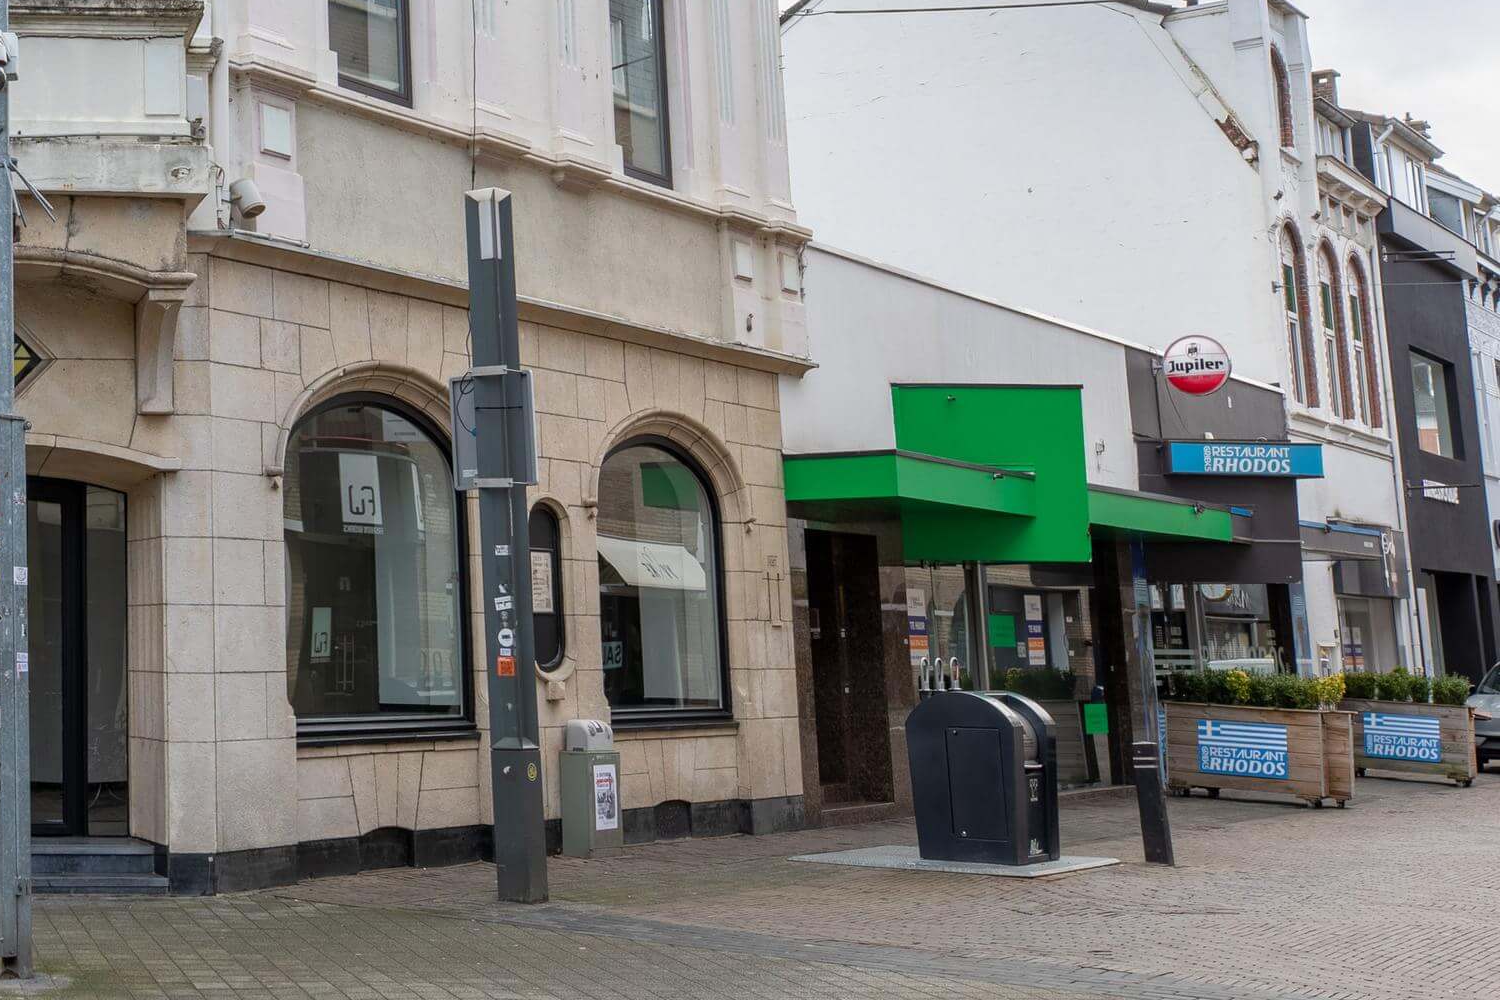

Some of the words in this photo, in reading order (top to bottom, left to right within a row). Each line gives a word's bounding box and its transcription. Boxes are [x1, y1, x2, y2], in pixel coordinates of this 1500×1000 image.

[1169, 358, 1224, 374] Jupiler
[1212, 447, 1290, 459] RESTAURANT
[1212, 459, 1291, 473] RHODOS
[1373, 735, 1439, 748] RESTAURANT
[1209, 746, 1285, 762] RESTAURANT
[1374, 744, 1438, 760] RHODOS
[1210, 757, 1286, 776] RHODOS
